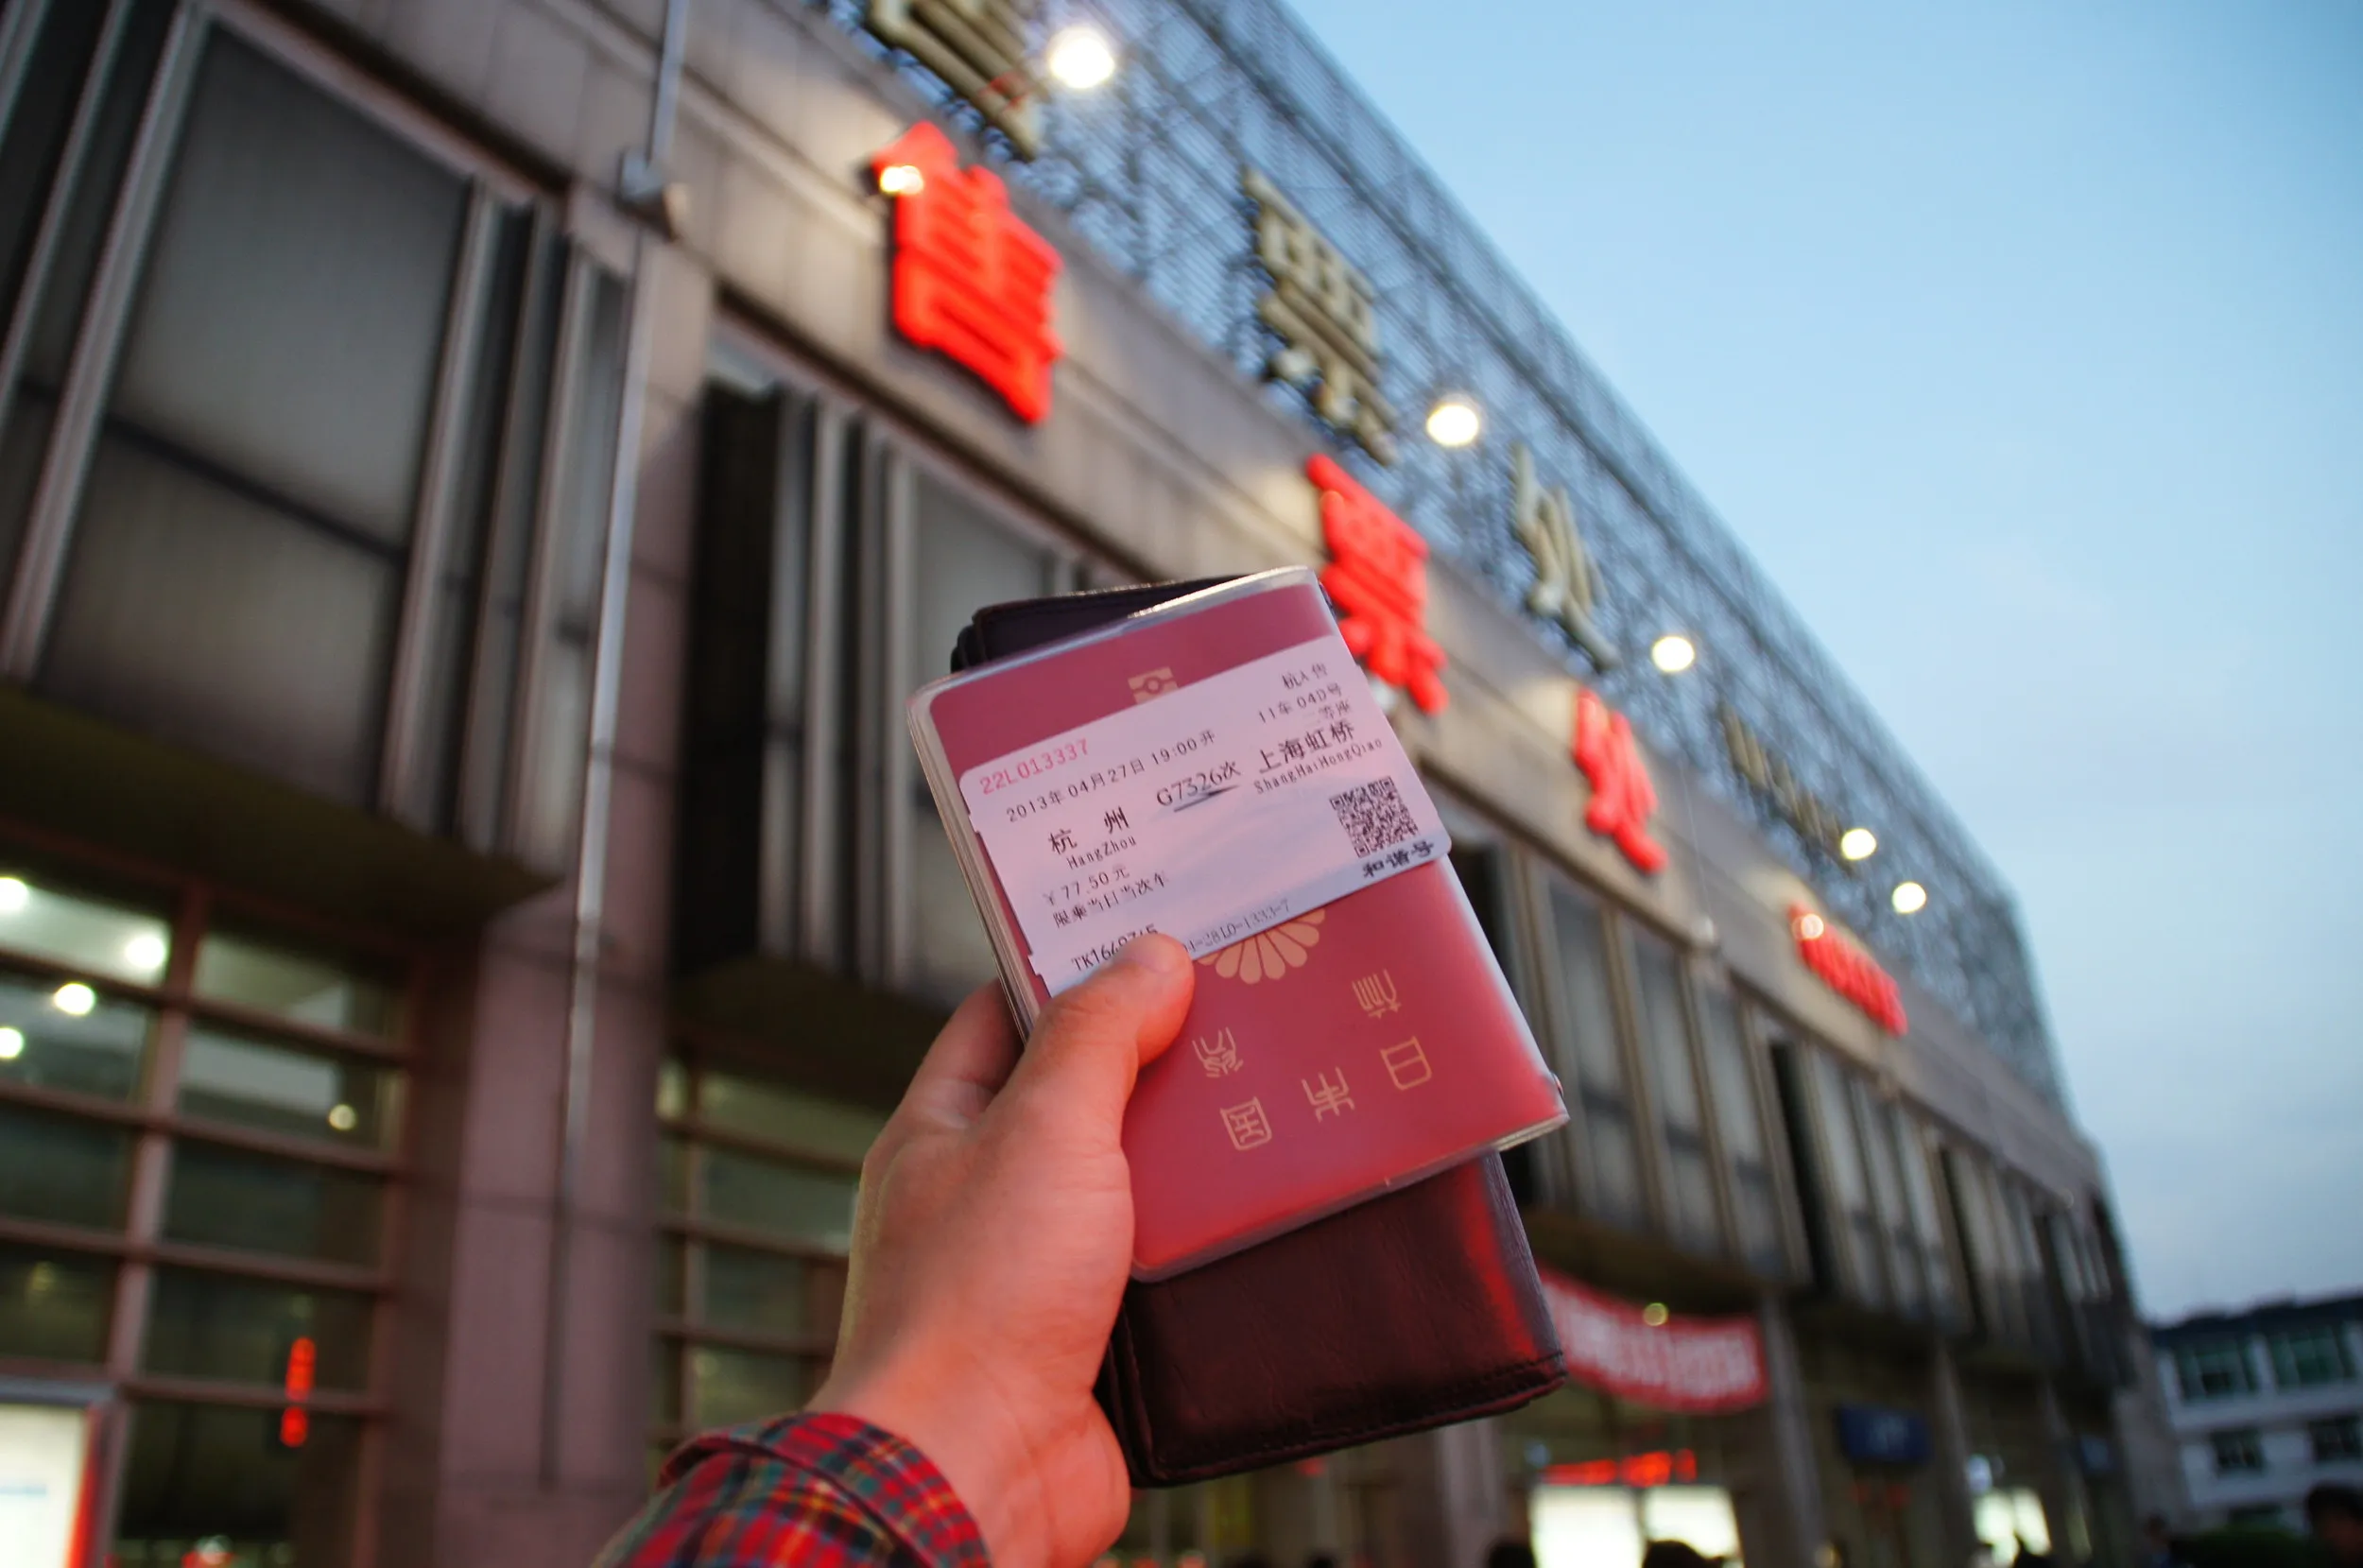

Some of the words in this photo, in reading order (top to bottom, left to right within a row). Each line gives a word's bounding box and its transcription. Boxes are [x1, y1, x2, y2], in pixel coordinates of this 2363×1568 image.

[979, 738, 1089, 795] 22L013337
[1253, 738, 1383, 794] ShangHaiHongQiao
[1258, 720, 1354, 774] 上海虹桥
[1066, 836, 1137, 870] HangZhou
[1361, 838, 1436, 879] 和谐号
